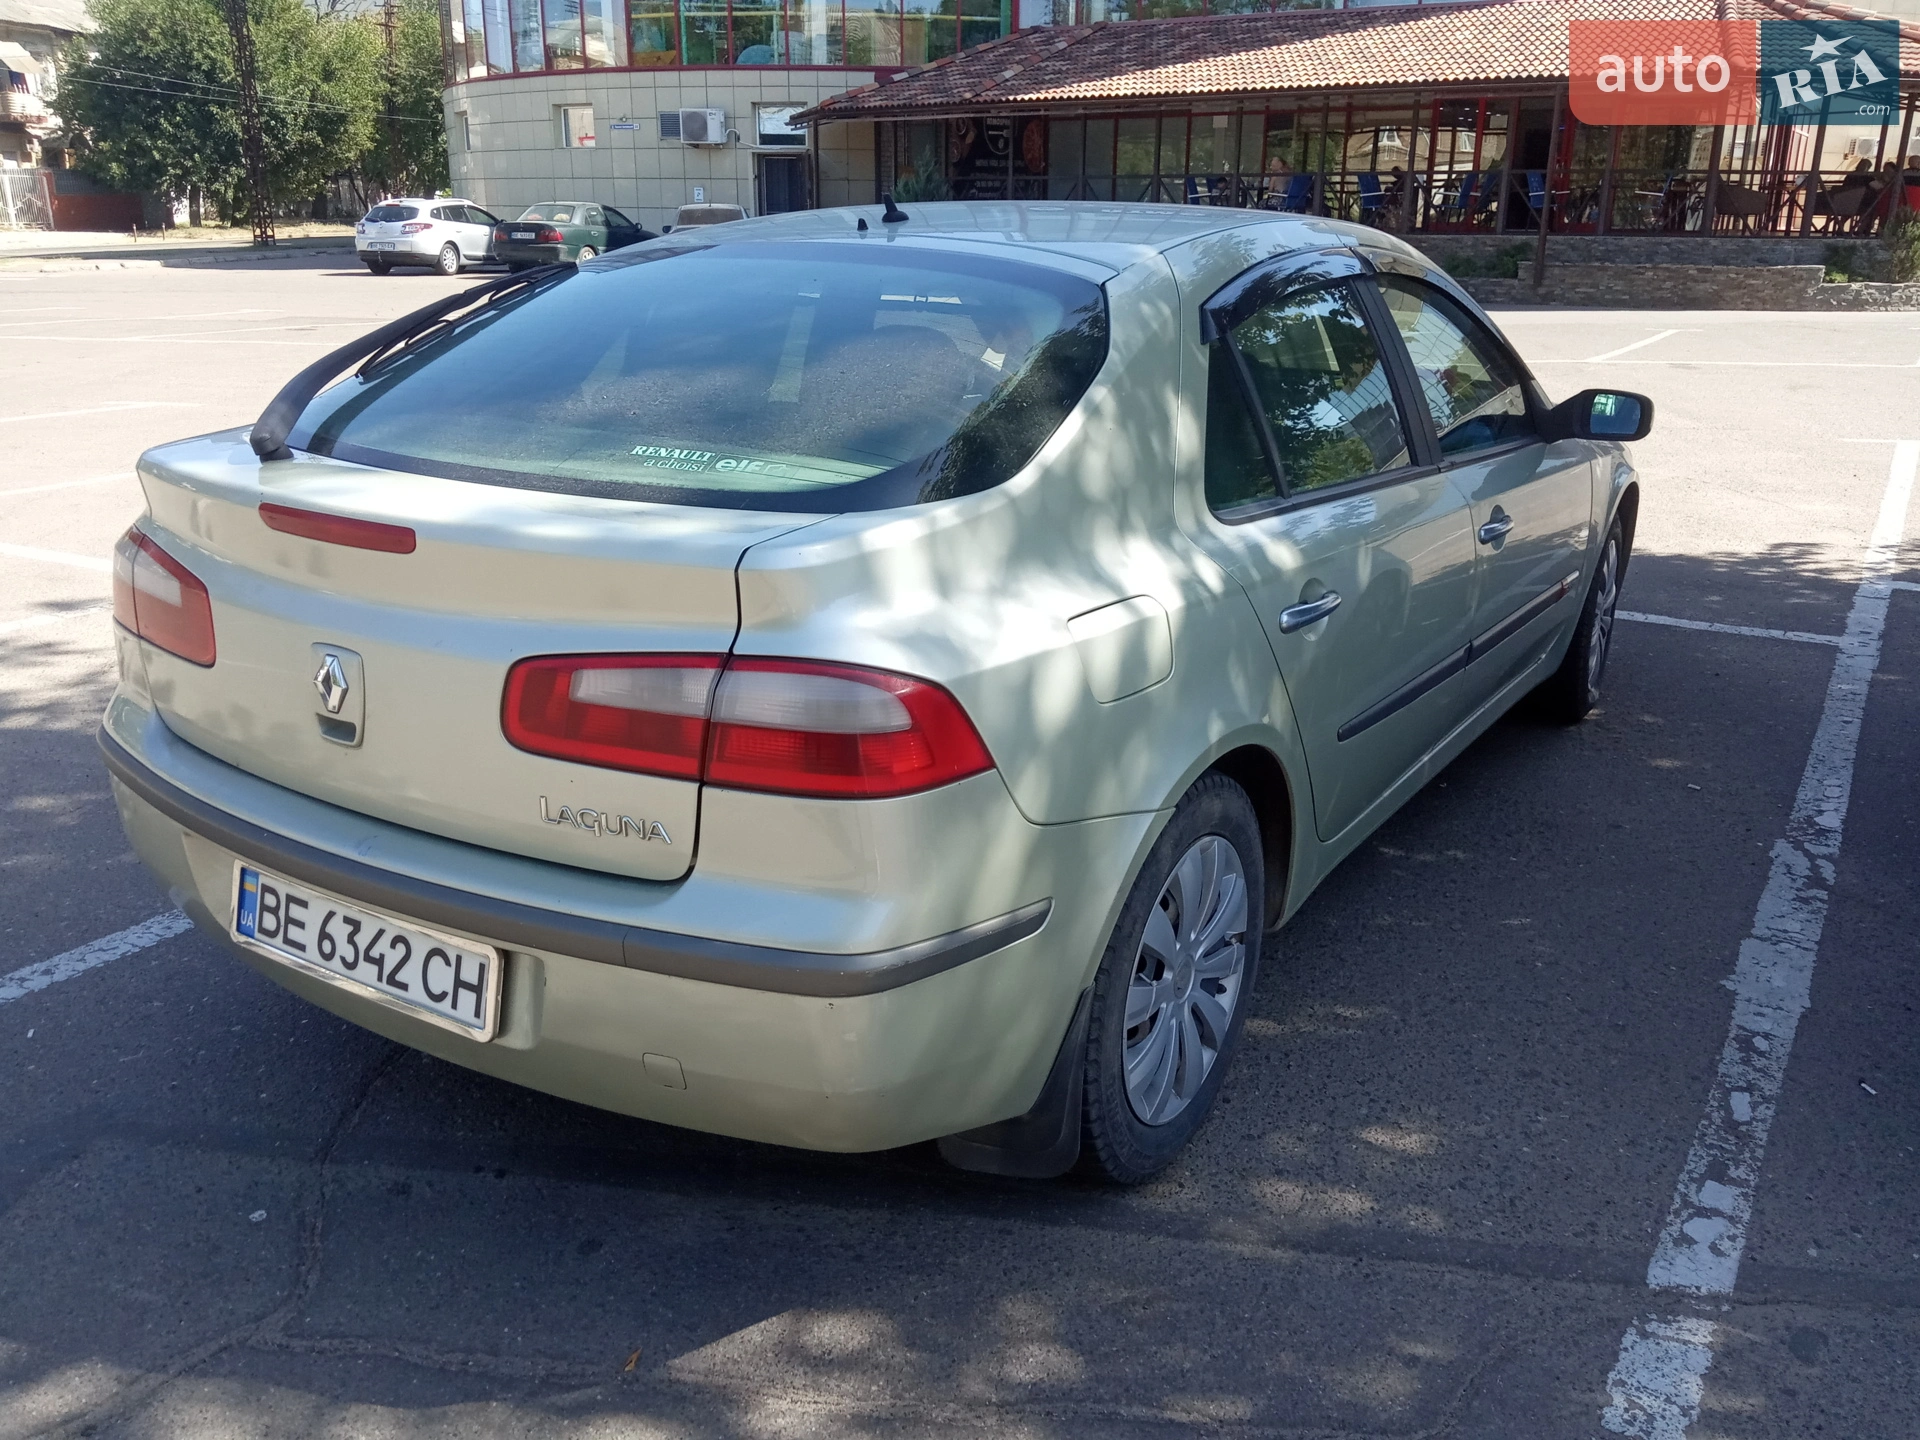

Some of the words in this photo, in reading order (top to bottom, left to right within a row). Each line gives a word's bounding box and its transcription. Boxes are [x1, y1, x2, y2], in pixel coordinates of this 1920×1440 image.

[630, 445, 716, 462] RENAULT
[643, 458, 656, 467] a
[657, 458, 708, 472] choisi
[715, 458, 765, 472] elf
[539, 795, 672, 845] LAGUNA
[240, 908, 254, 929] UA
[257, 883, 309, 953] BE
[317, 910, 412, 993] 6342
[422, 947, 487, 1019] CH
